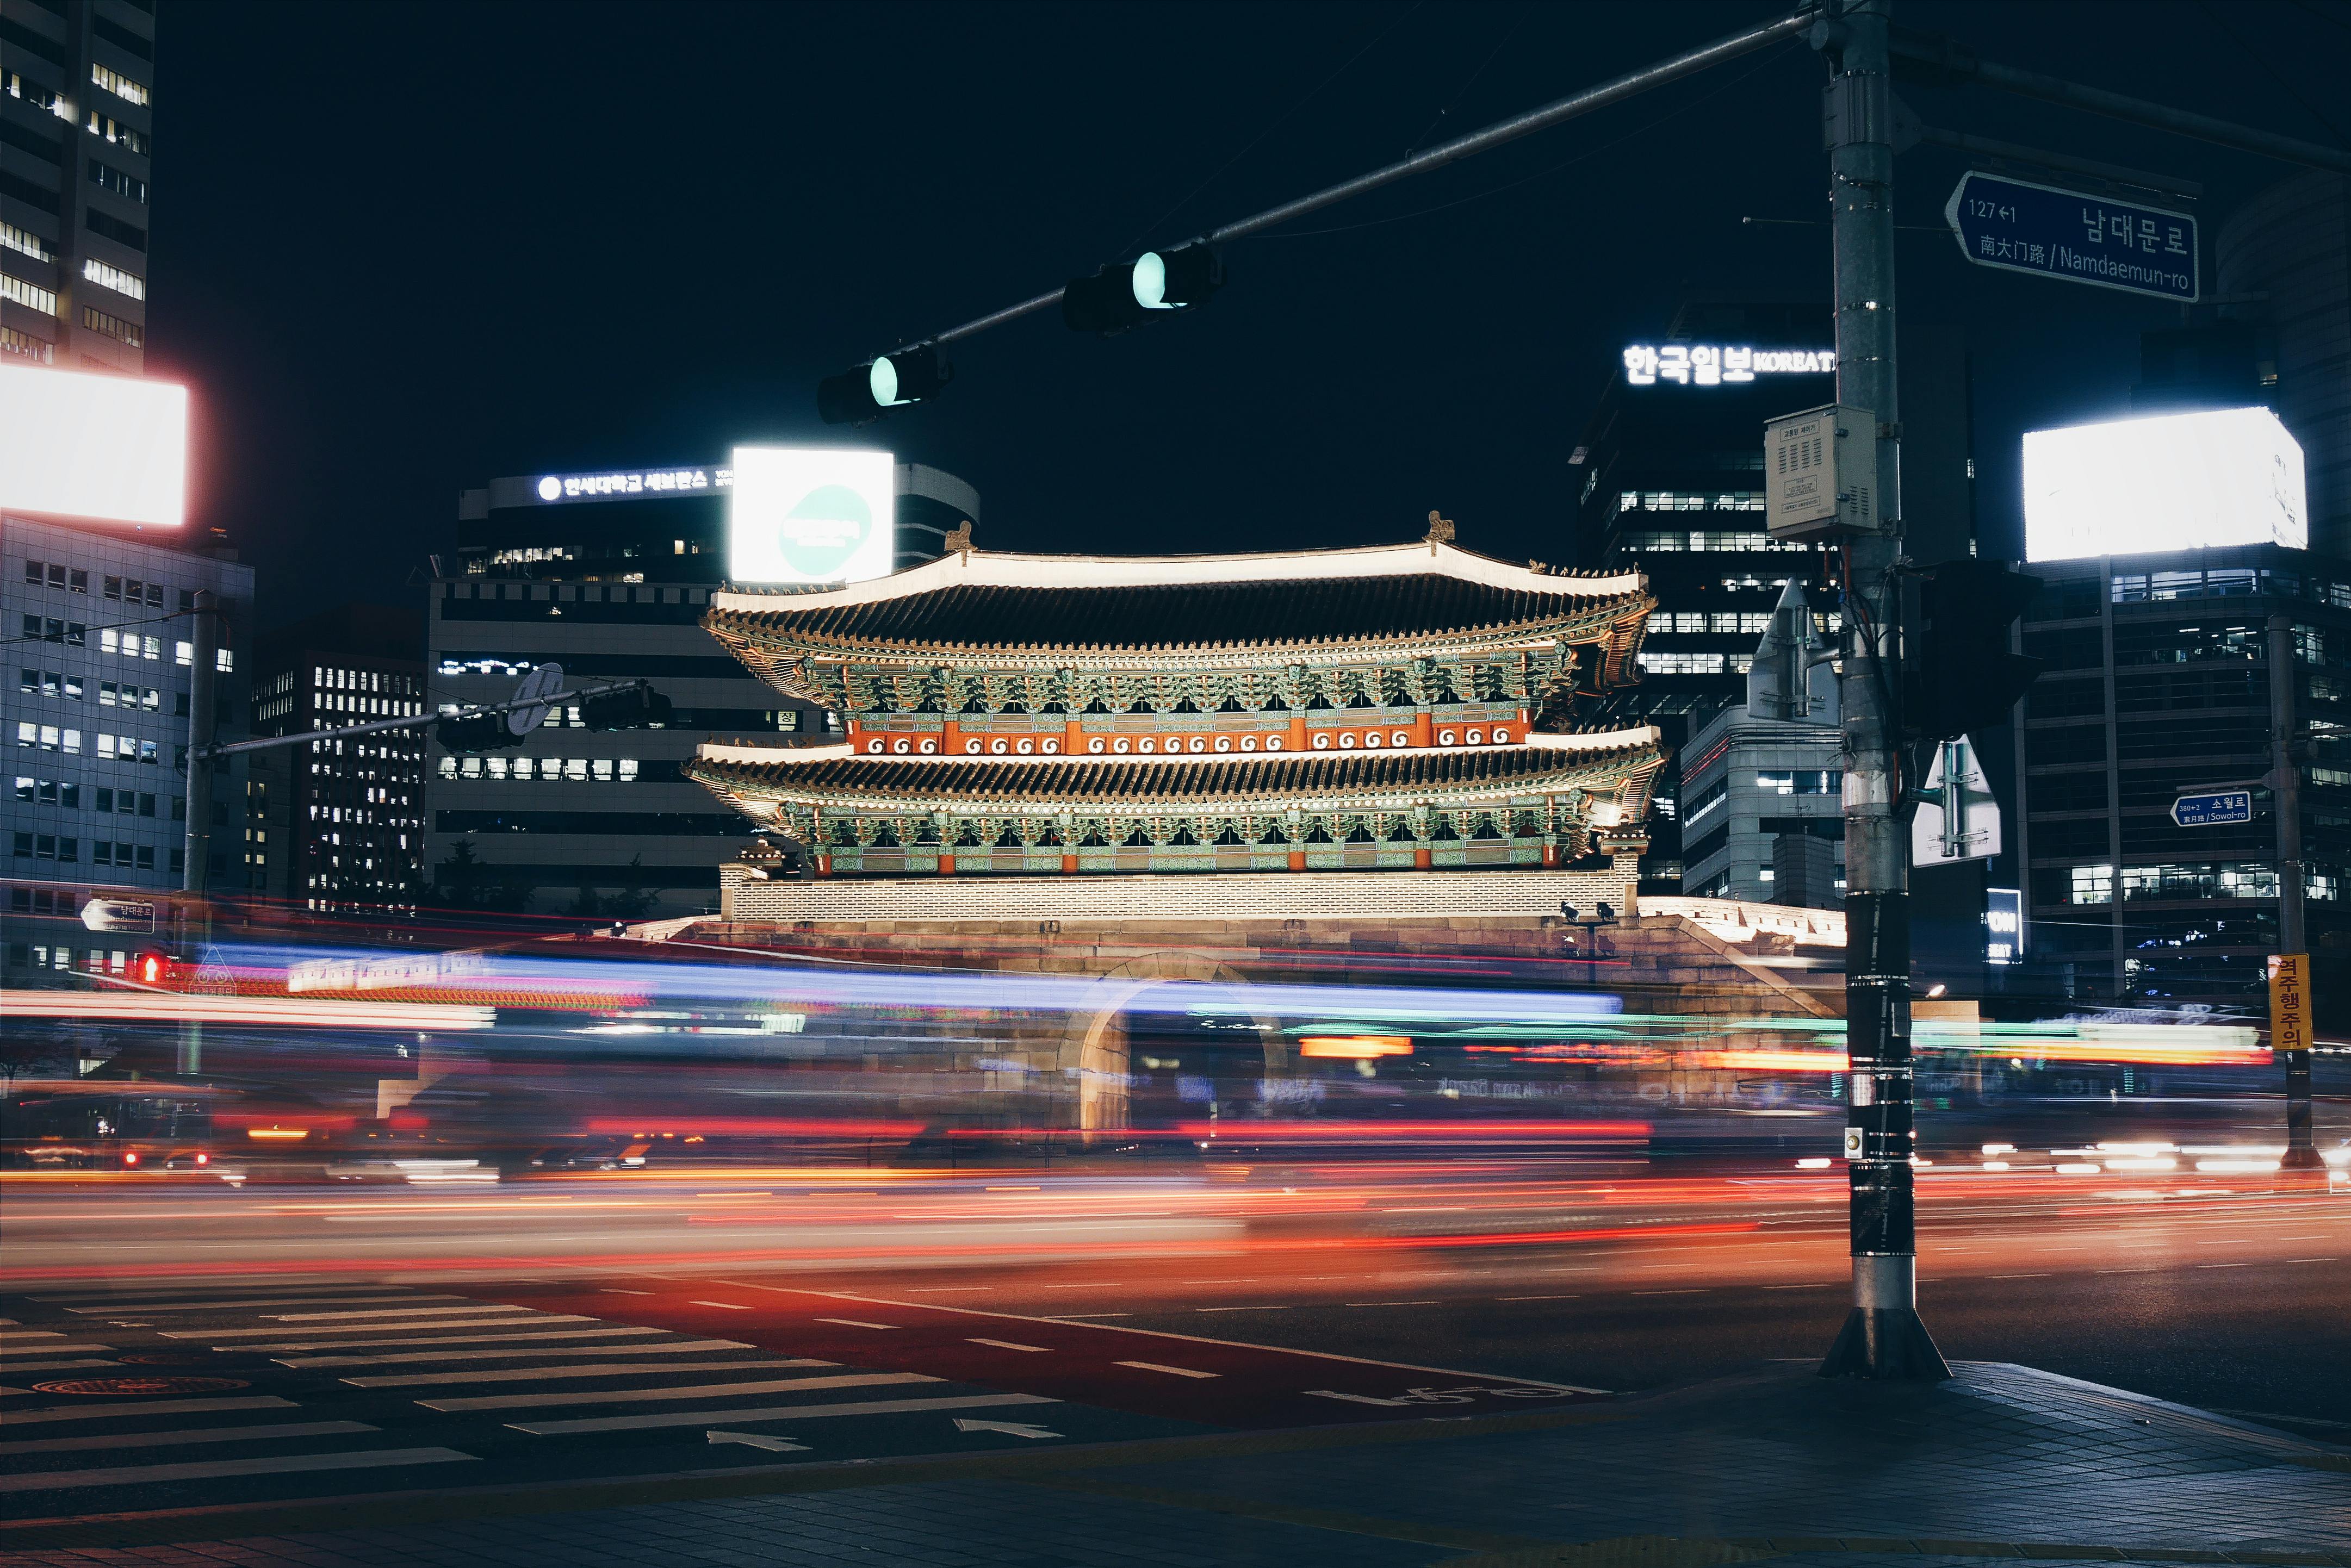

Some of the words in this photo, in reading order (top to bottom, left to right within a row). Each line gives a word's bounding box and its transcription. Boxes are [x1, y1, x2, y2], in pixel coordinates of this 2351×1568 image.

[1969, 198, 1995, 218] 127
[2082, 208, 2187, 255] 남대문로
[1981, 235, 2044, 265] 南大门路
[2061, 247, 2188, 290] Namdaemun-ro
[1624, 346, 1754, 384] 한국일보
[781, 712, 793, 723] 상
[2211, 797, 2245, 810] 소월로
[2211, 811, 2246, 820] Sowol-ro
[121, 905, 152, 916] 남대문로
[2278, 958, 2302, 1047] 역주행주의
